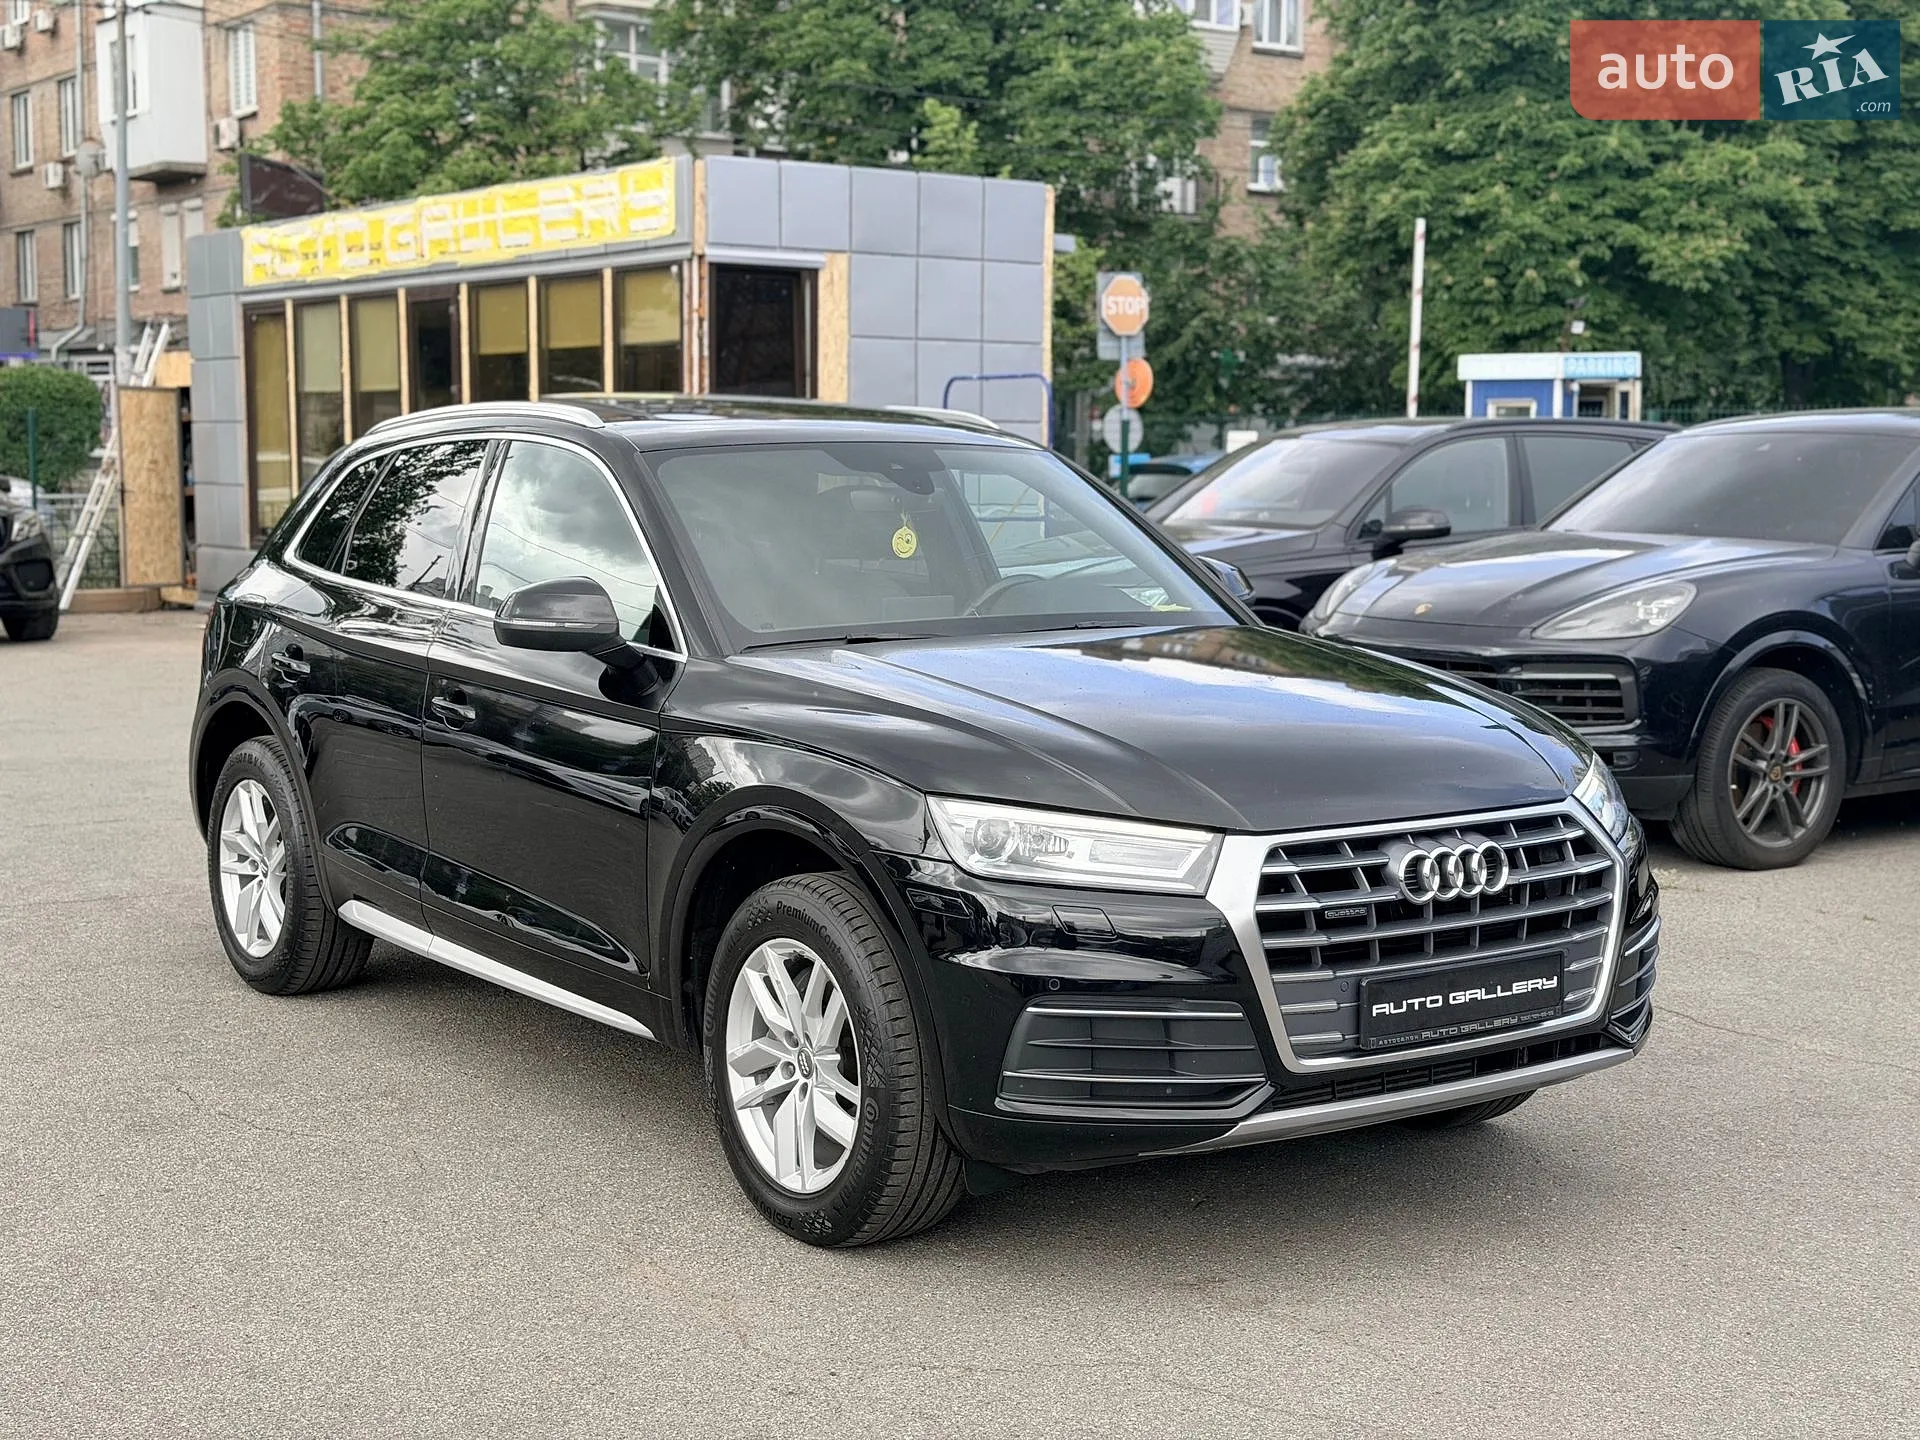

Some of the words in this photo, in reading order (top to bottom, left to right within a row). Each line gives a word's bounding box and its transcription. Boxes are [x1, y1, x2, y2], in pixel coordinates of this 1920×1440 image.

[1106, 296, 1147, 315] STOP
[1567, 357, 1635, 376] PARKING
[1372, 994, 1442, 1017] AUTO
[1449, 975, 1558, 1005] GALLERY
[1421, 1026, 1458, 1040] AUTO
[1459, 1015, 1518, 1033] GALLERY
